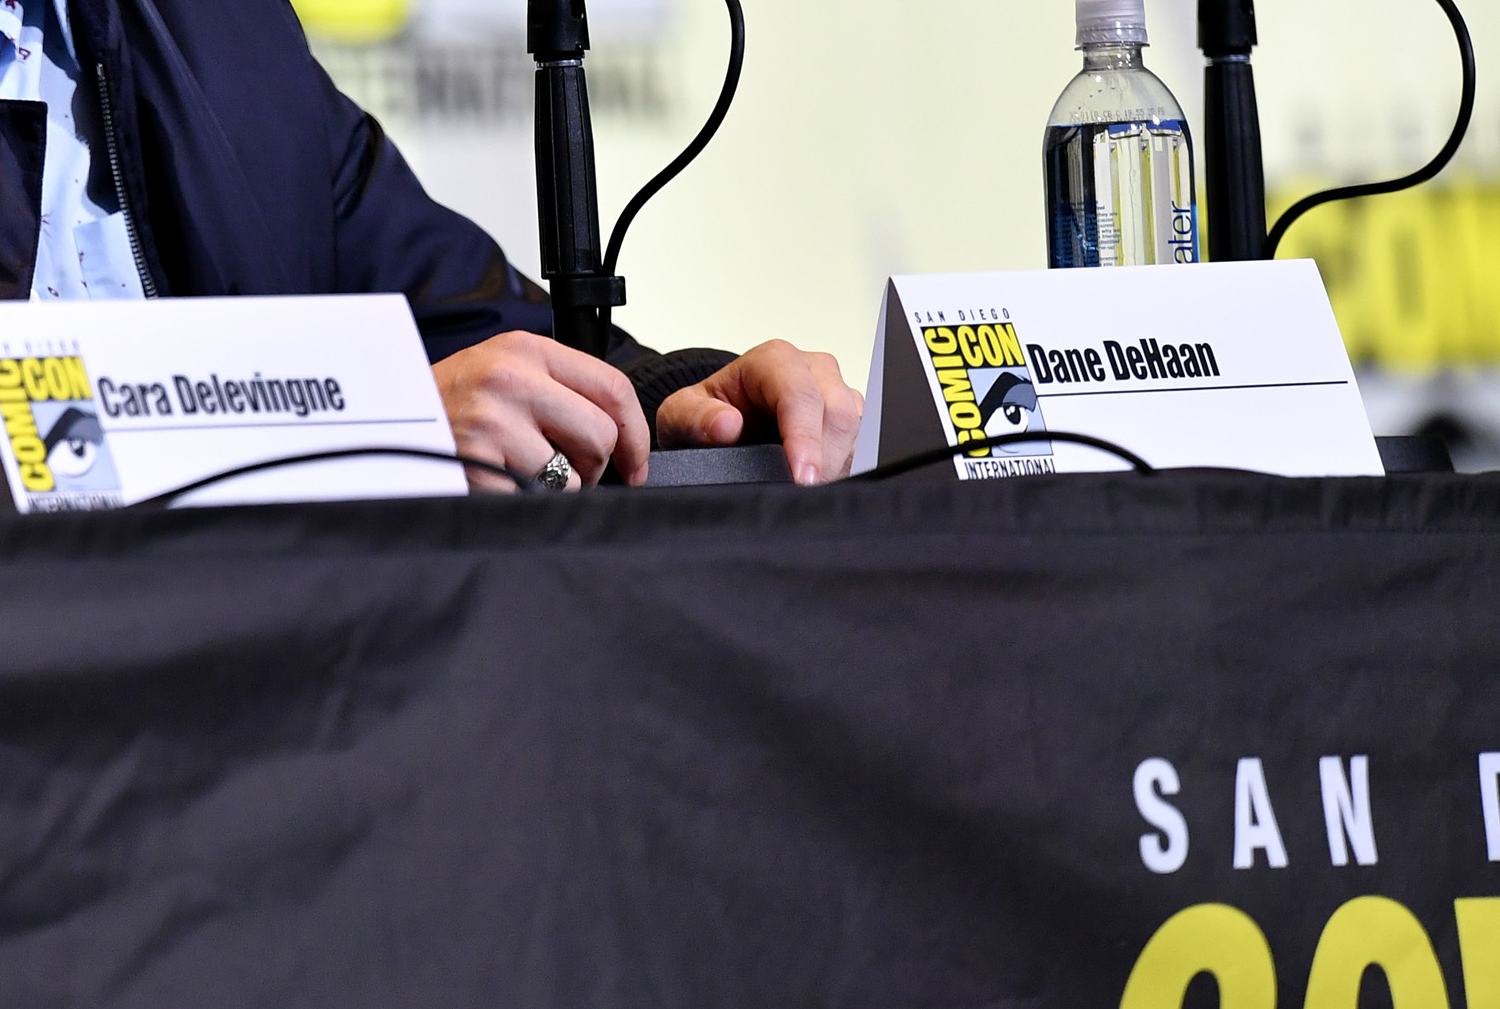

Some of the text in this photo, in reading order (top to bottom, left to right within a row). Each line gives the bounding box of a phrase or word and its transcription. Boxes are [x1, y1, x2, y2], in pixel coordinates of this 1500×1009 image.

[1168, 201, 1193, 264] ater
[914, 307, 1010, 324] SAN DIEGO
[957, 323, 1026, 368] CON
[1026, 338, 1221, 384] Dane DeHaan
[21, 356, 93, 402] CON
[97, 371, 346, 418] Cara Delevingne
[924, 327, 990, 457] COMIC
[1133, 755, 1379, 874] SAN
